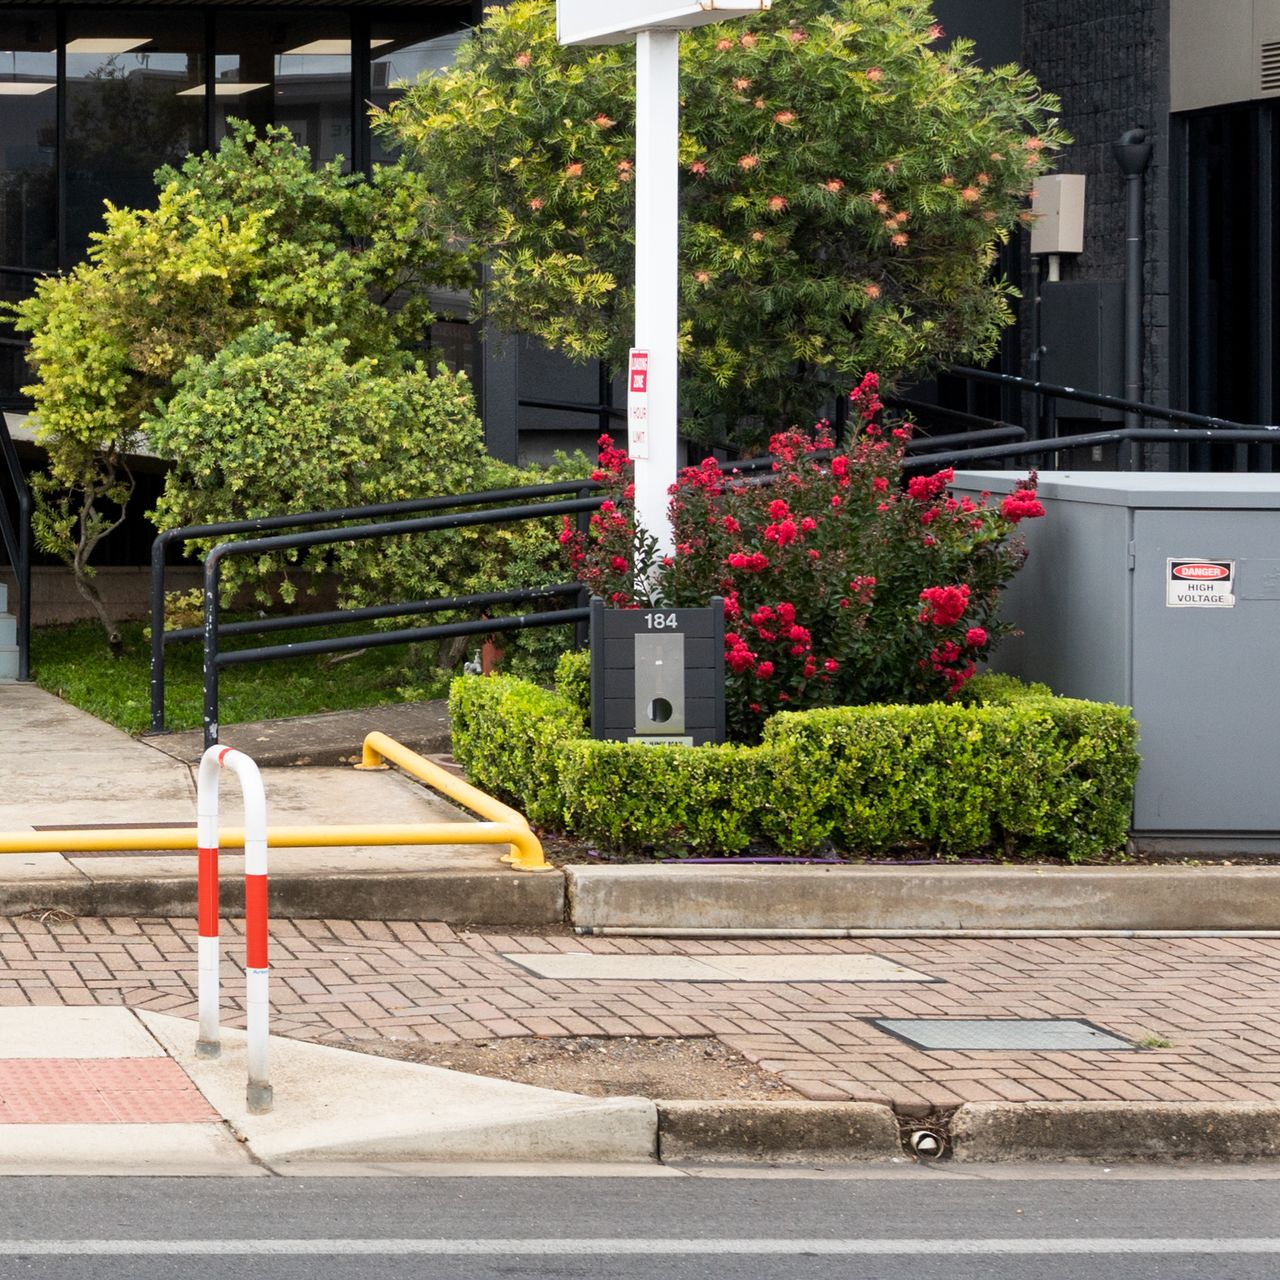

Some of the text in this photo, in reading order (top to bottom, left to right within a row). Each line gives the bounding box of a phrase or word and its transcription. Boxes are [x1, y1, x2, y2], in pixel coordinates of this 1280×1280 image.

[1181, 567, 1221, 576] DANGER
[1188, 583, 1214, 592] HIGH
[1177, 594, 1224, 603] VOLTAGE
[644, 613, 678, 629] 184
